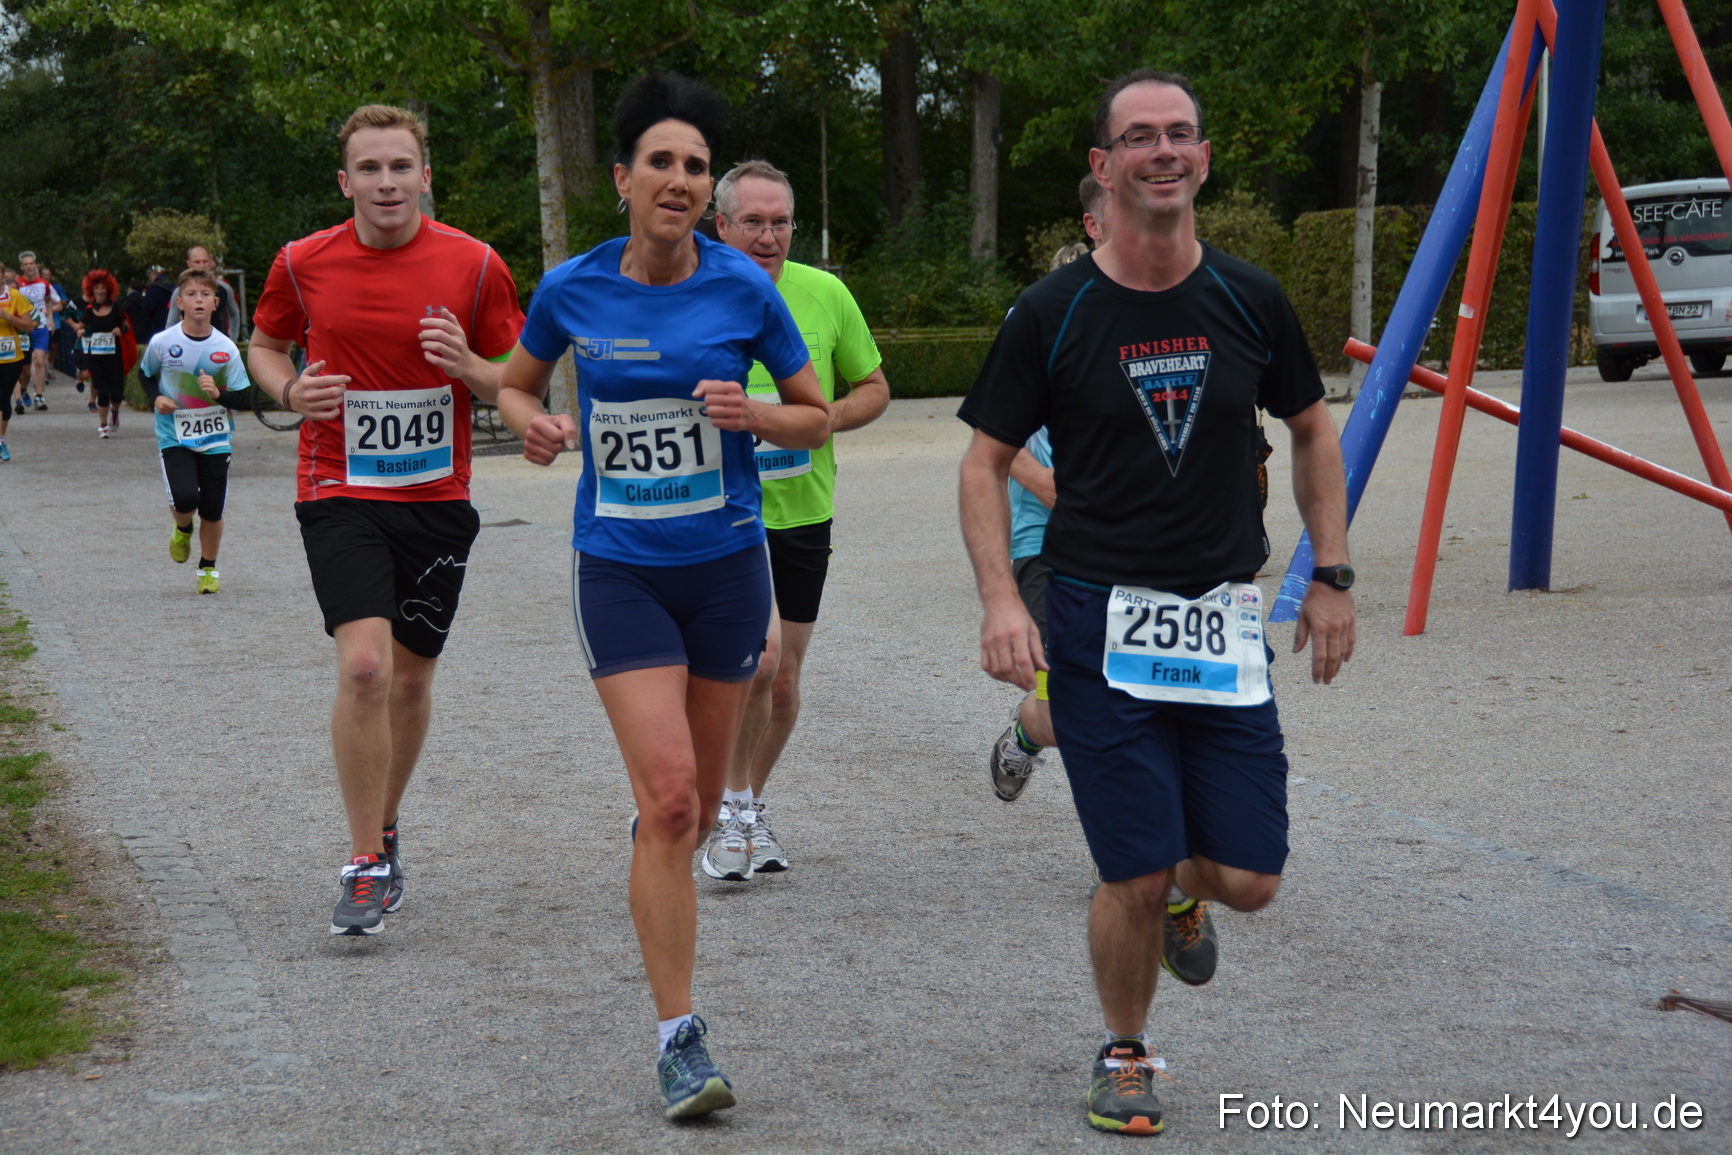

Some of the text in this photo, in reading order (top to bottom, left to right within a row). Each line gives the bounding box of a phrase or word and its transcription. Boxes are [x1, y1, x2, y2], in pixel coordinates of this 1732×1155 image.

[1119, 336, 1210, 360] FINISHER
[1128, 355, 1206, 378] BRAVEHEART
[1144, 375, 1194, 391] BATTLE
[347, 398, 437, 410] PARTL Neumarkt
[1152, 389, 1189, 403] 2014
[630, 407, 694, 424] Neumarkt
[1178, 422, 1190, 450] POWERED
[1193, 386, 1201, 401] TEAM
[181, 416, 225, 437] 2466
[357, 410, 445, 450] 2049
[601, 423, 705, 472] 2551
[376, 458, 427, 473] Bastian
[755, 454, 795, 471] lfgang
[625, 482, 690, 502] Claudia
[1122, 605, 1226, 656] 2598
[1152, 662, 1201, 683] Frank
